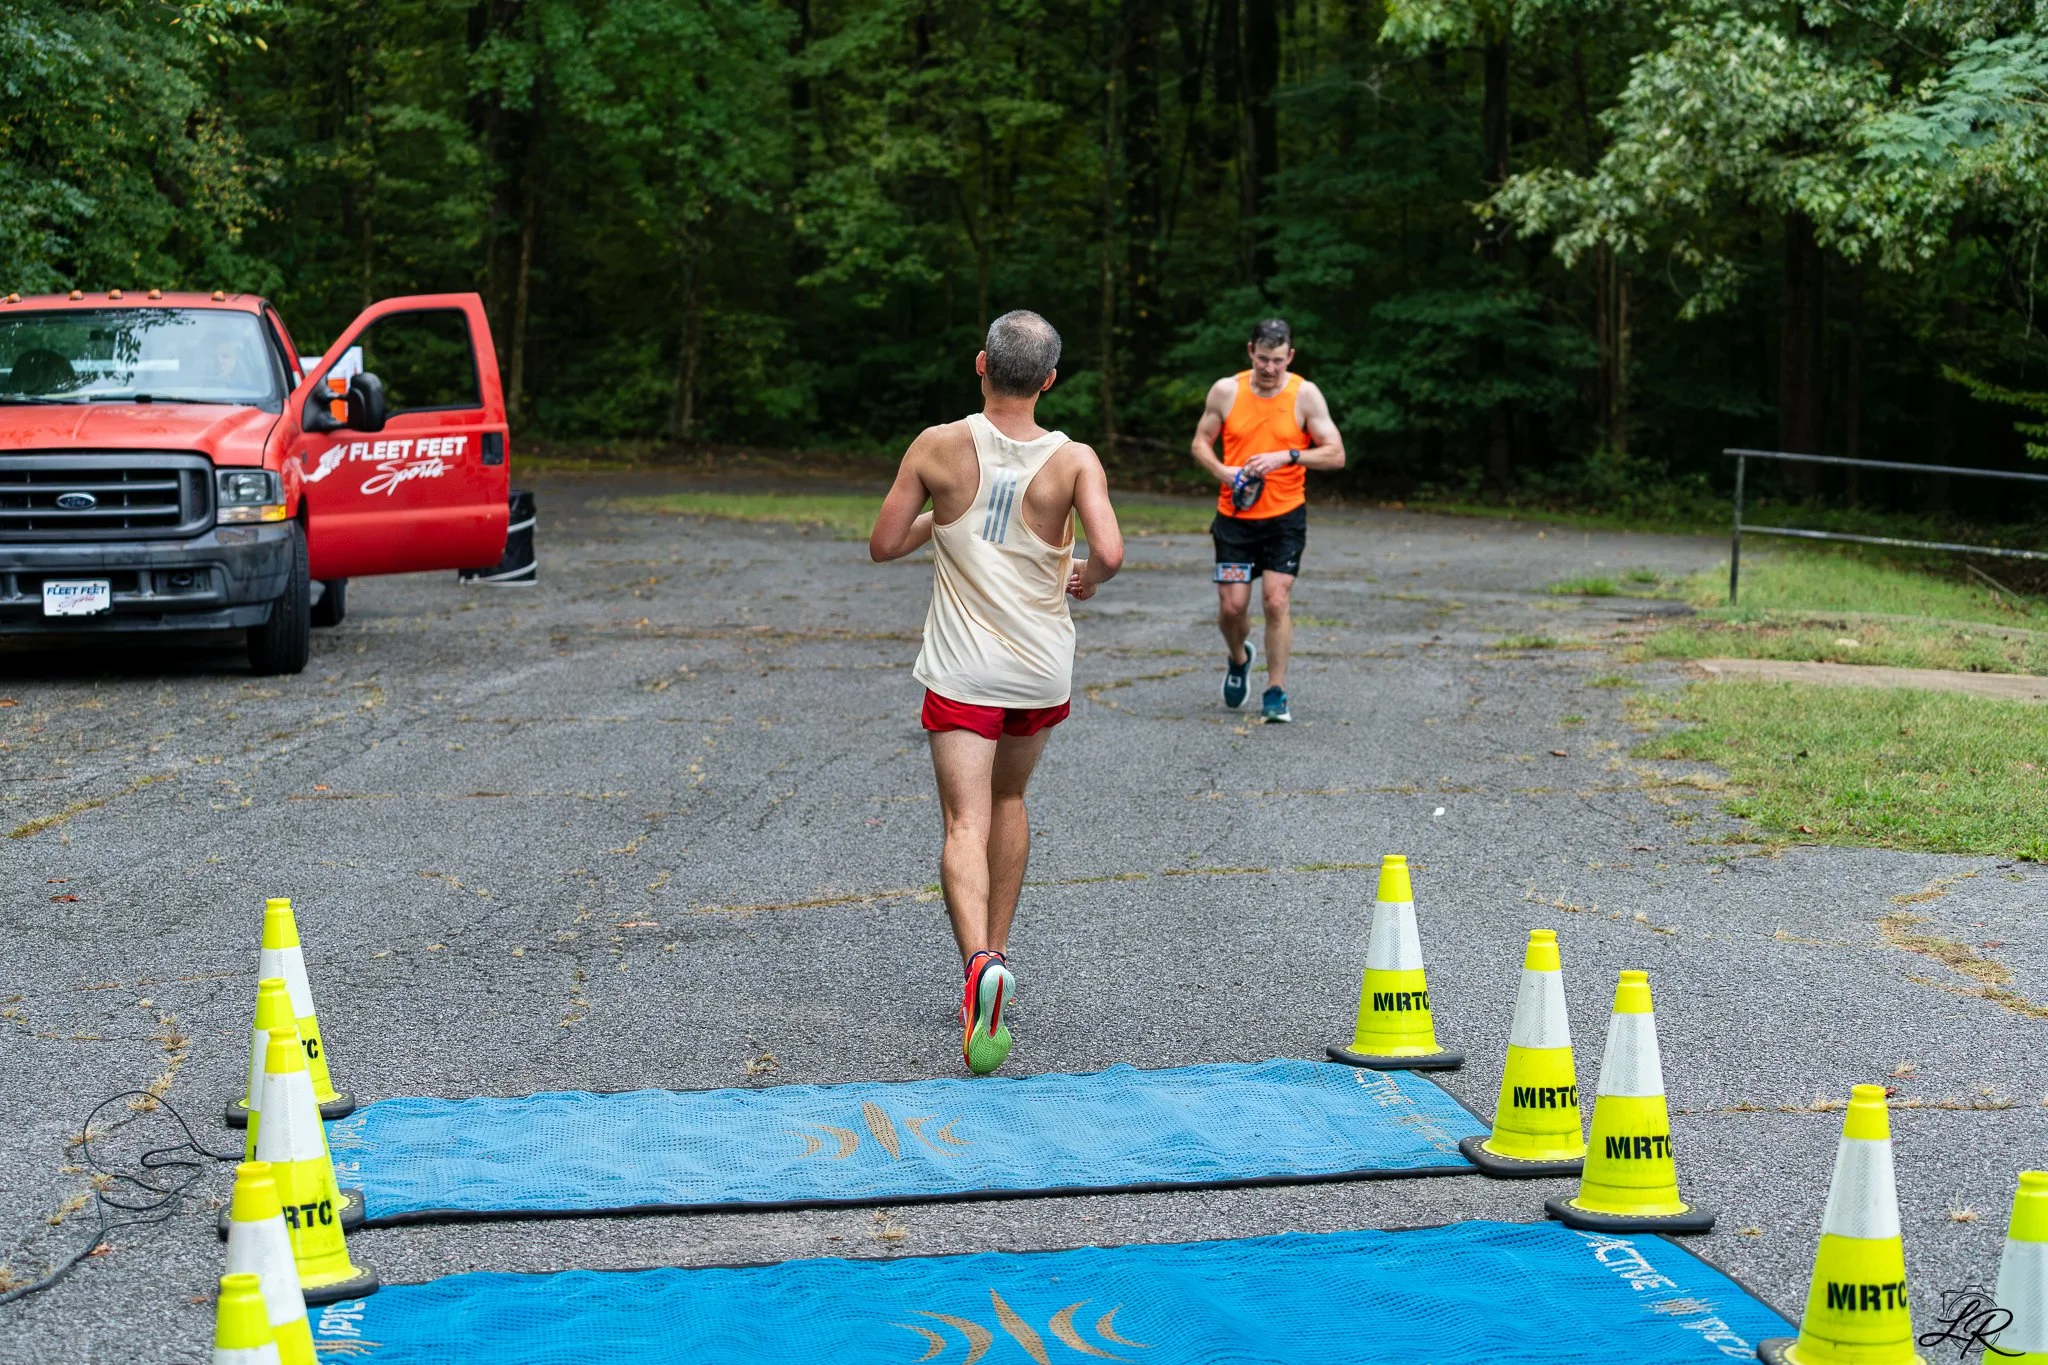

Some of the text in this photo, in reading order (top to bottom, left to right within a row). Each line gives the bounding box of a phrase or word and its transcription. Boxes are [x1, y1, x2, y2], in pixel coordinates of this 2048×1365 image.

[349, 436, 468, 462] FLEET FEET
[360, 457, 454, 497] Sports
[47, 586, 107, 596] FLEET FEET
[1373, 990, 1430, 1012] MRTC
[1513, 1085, 1578, 1109] MRTC
[1605, 1133, 1673, 1160] MRTC
[282, 1199, 333, 1230] RTC
[1827, 1280, 1907, 1311] MRTC
